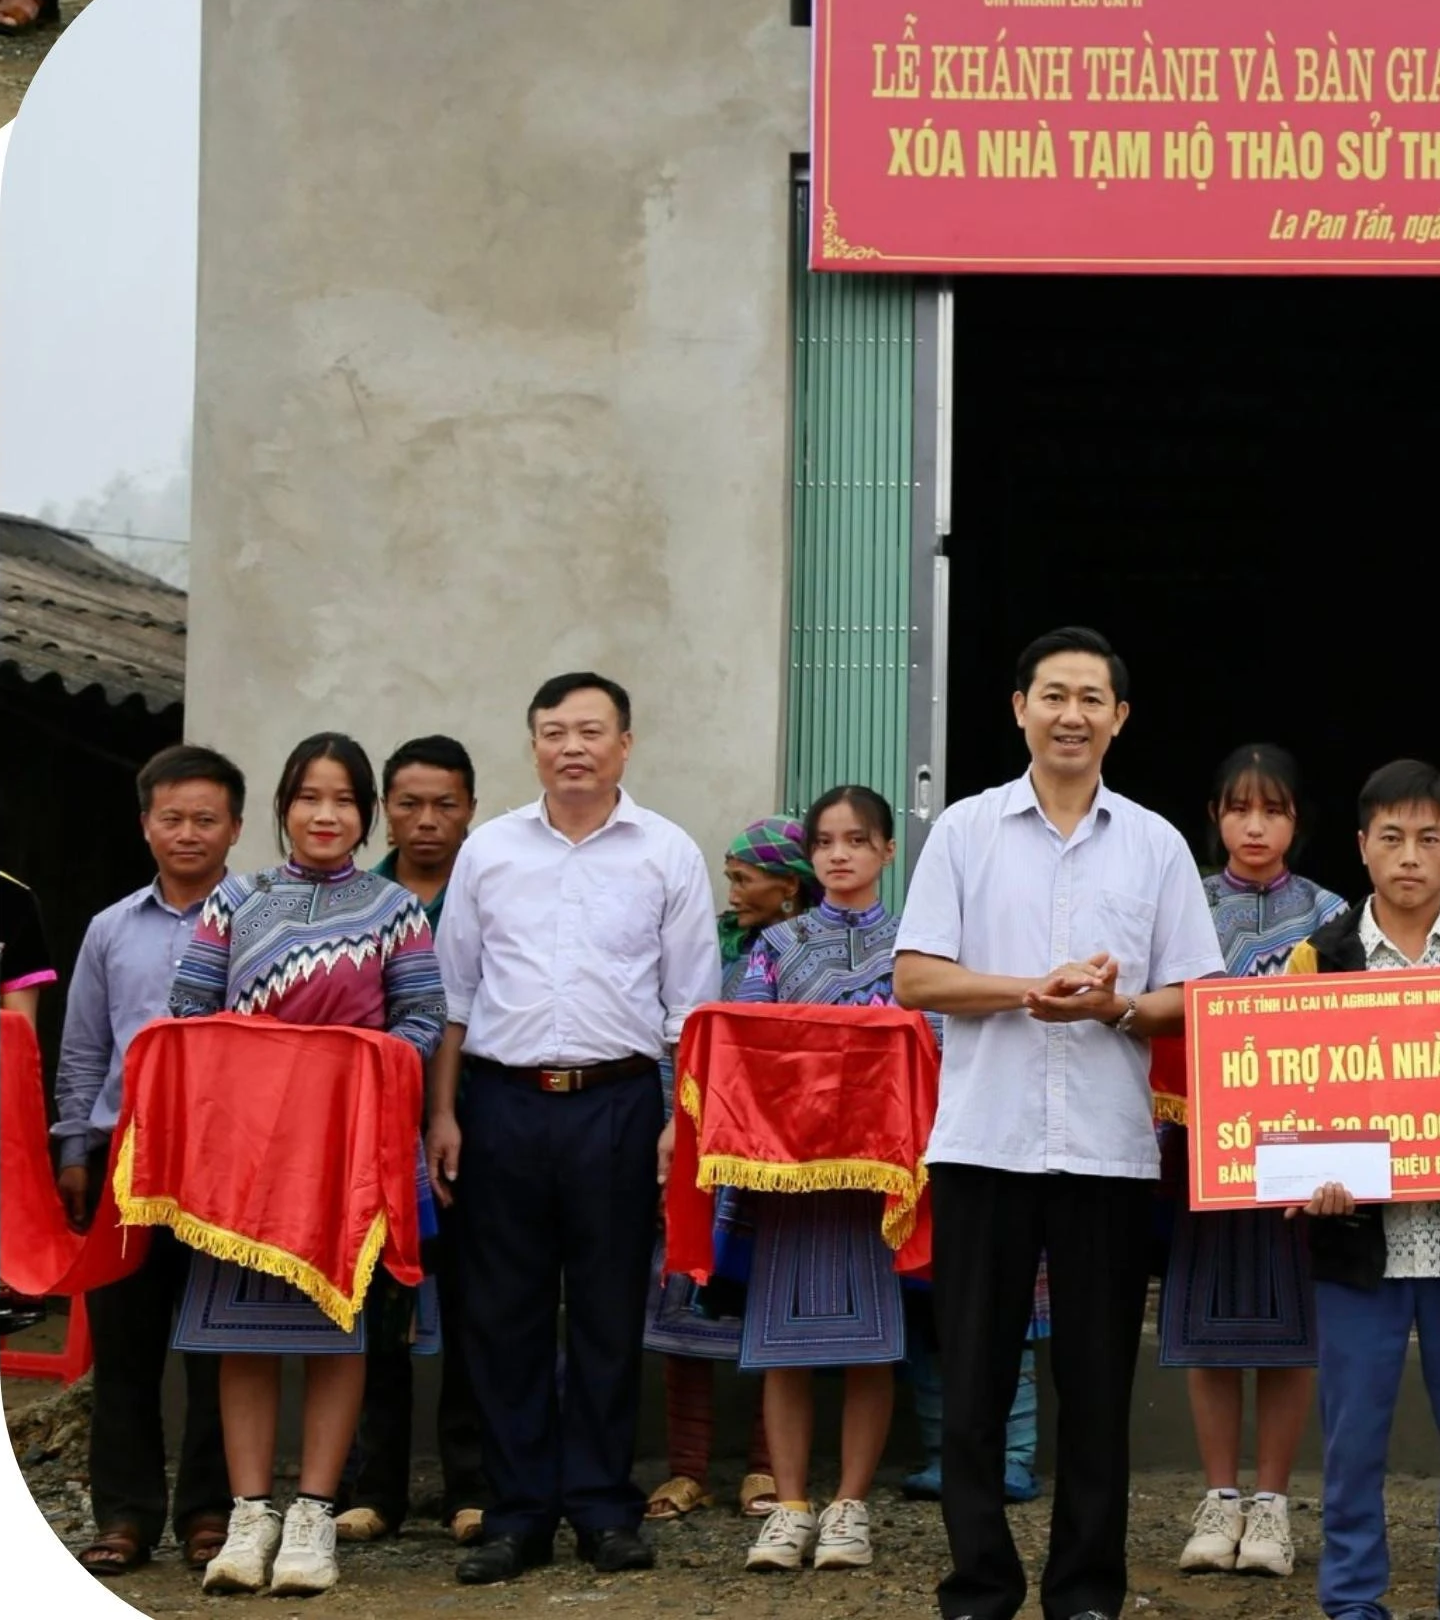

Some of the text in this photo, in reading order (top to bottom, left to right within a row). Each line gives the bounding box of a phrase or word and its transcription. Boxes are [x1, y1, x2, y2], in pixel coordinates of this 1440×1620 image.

[871, 12, 920, 99] LỄ
[930, 27, 1073, 101] KHÁNH
[1082, 29, 1220, 102] THÀNH
[1229, 29, 1284, 102] VÀ
[1294, 29, 1375, 102] BÀN
[887, 118, 966, 178] XÓA
[977, 118, 1058, 179] NHÀ
[1069, 130, 1151, 191] TẠM
[1163, 120, 1214, 191] HỘ
[1225, 120, 1324, 181] THÀO
[1336, 110, 1393, 181] SỬ
[1268, 209, 1299, 240] La
[1300, 209, 1346, 240] Pan
[1208, 997, 1225, 1016] SỞ
[1227, 1001, 1235, 1015] Y
[1236, 995, 1251, 1015] TẾ
[1253, 994, 1280, 1014] TỈNH
[1283, 994, 1298, 1012] LÀ
[1300, 996, 1321, 1011] CAI
[1323, 992, 1339, 1010] VÀ
[1341, 992, 1400, 1010] AGRIBANK
[1403, 990, 1424, 1007] CHI
[1222, 1035, 1259, 1089] HỖ
[1267, 1043, 1320, 1093] TRỢ
[1328, 1035, 1384, 1084] XOÁ
[1217, 1111, 1252, 1150] SỐ
